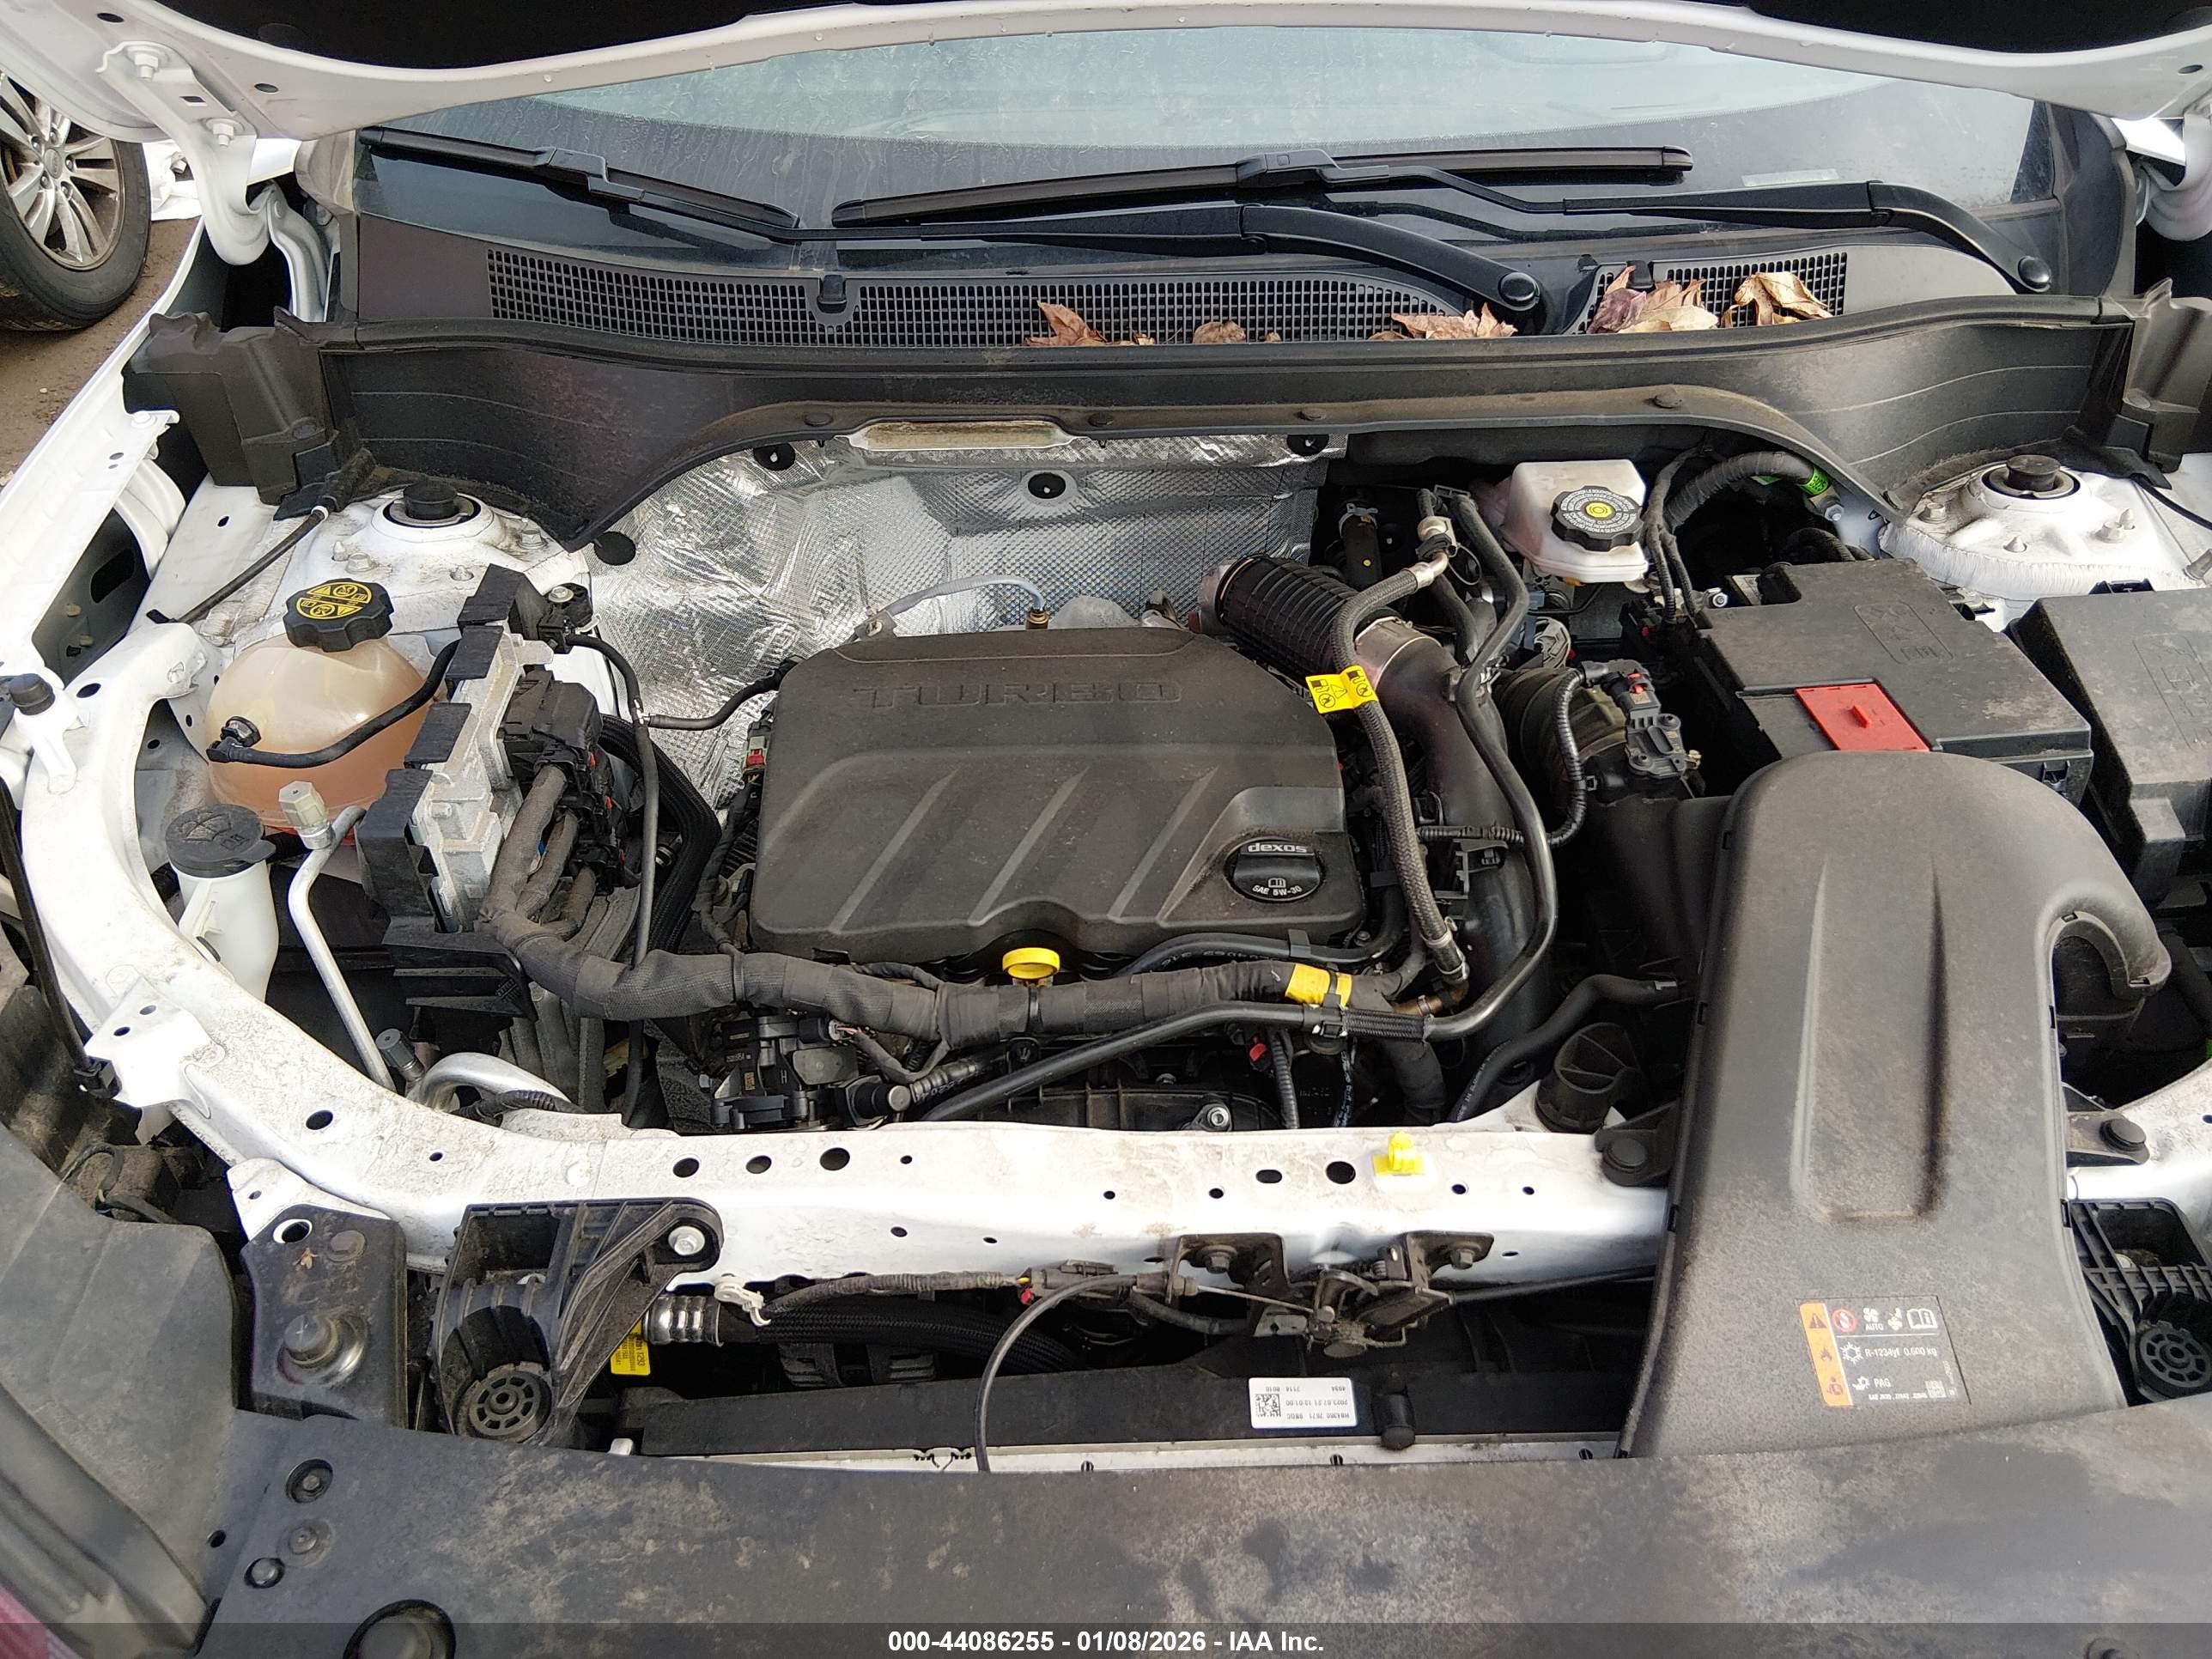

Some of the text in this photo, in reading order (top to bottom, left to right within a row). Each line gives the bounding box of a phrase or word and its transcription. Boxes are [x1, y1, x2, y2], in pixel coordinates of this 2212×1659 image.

[853, 682, 1182, 708] TURBO
[1248, 842, 1307, 853] dexos
[1252, 884, 1303, 896] SAE 5W-30
[1927, 1347, 1937, 1357] kg
[1874, 1377, 1891, 1388] PAG
